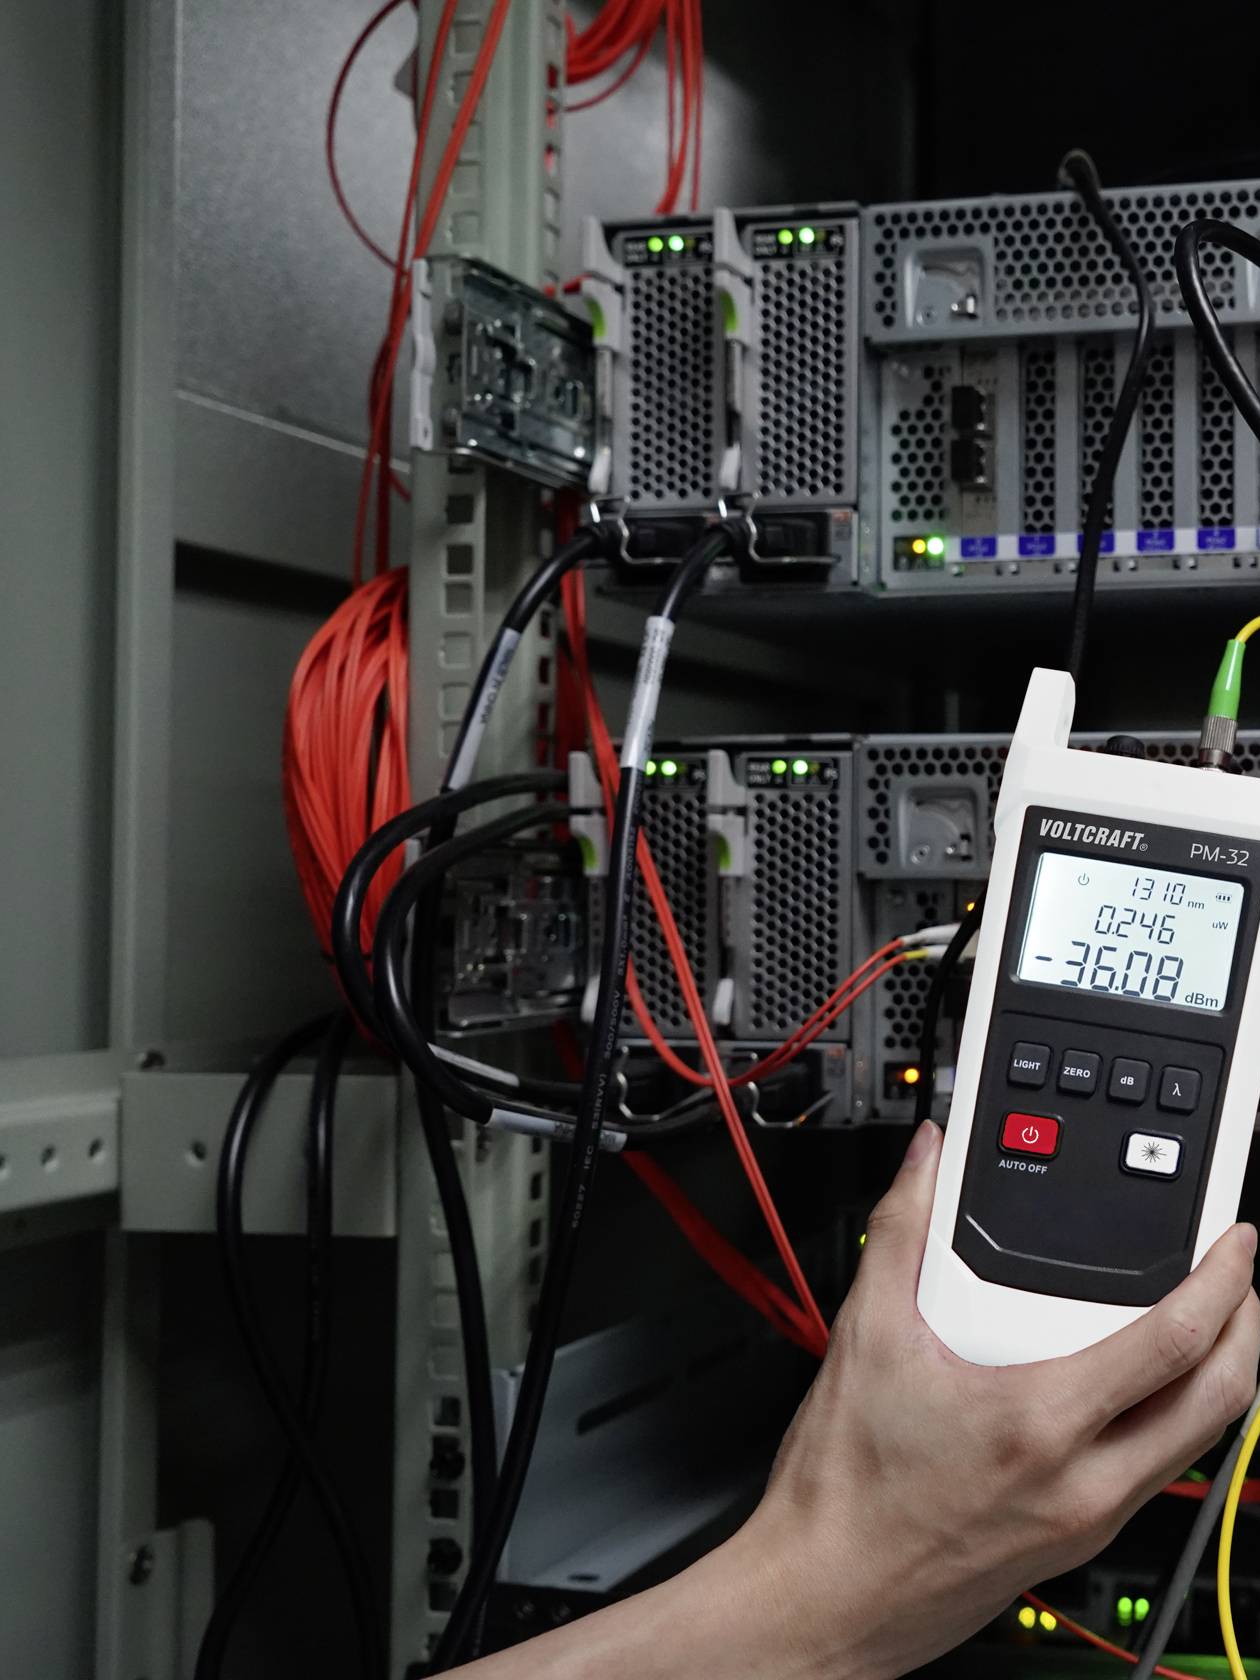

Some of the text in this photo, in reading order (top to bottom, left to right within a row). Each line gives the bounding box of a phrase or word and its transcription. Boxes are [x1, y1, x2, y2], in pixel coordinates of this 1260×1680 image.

[1039, 818, 1145, 851] VOLTCRAFT
[1190, 843, 1250, 867] PM-32
[1132, 877, 1205, 910] 1310 nm
[1095, 904, 1176, 945] 0.246
[1035, 940, 1219, 1009] -36.08 dBm
[1013, 1059, 1041, 1071] LIGHT
[1063, 1066, 1091, 1078] ZERO
[1120, 1076, 1135, 1086] dB
[998, 1159, 1048, 1175] AUTO OFF
